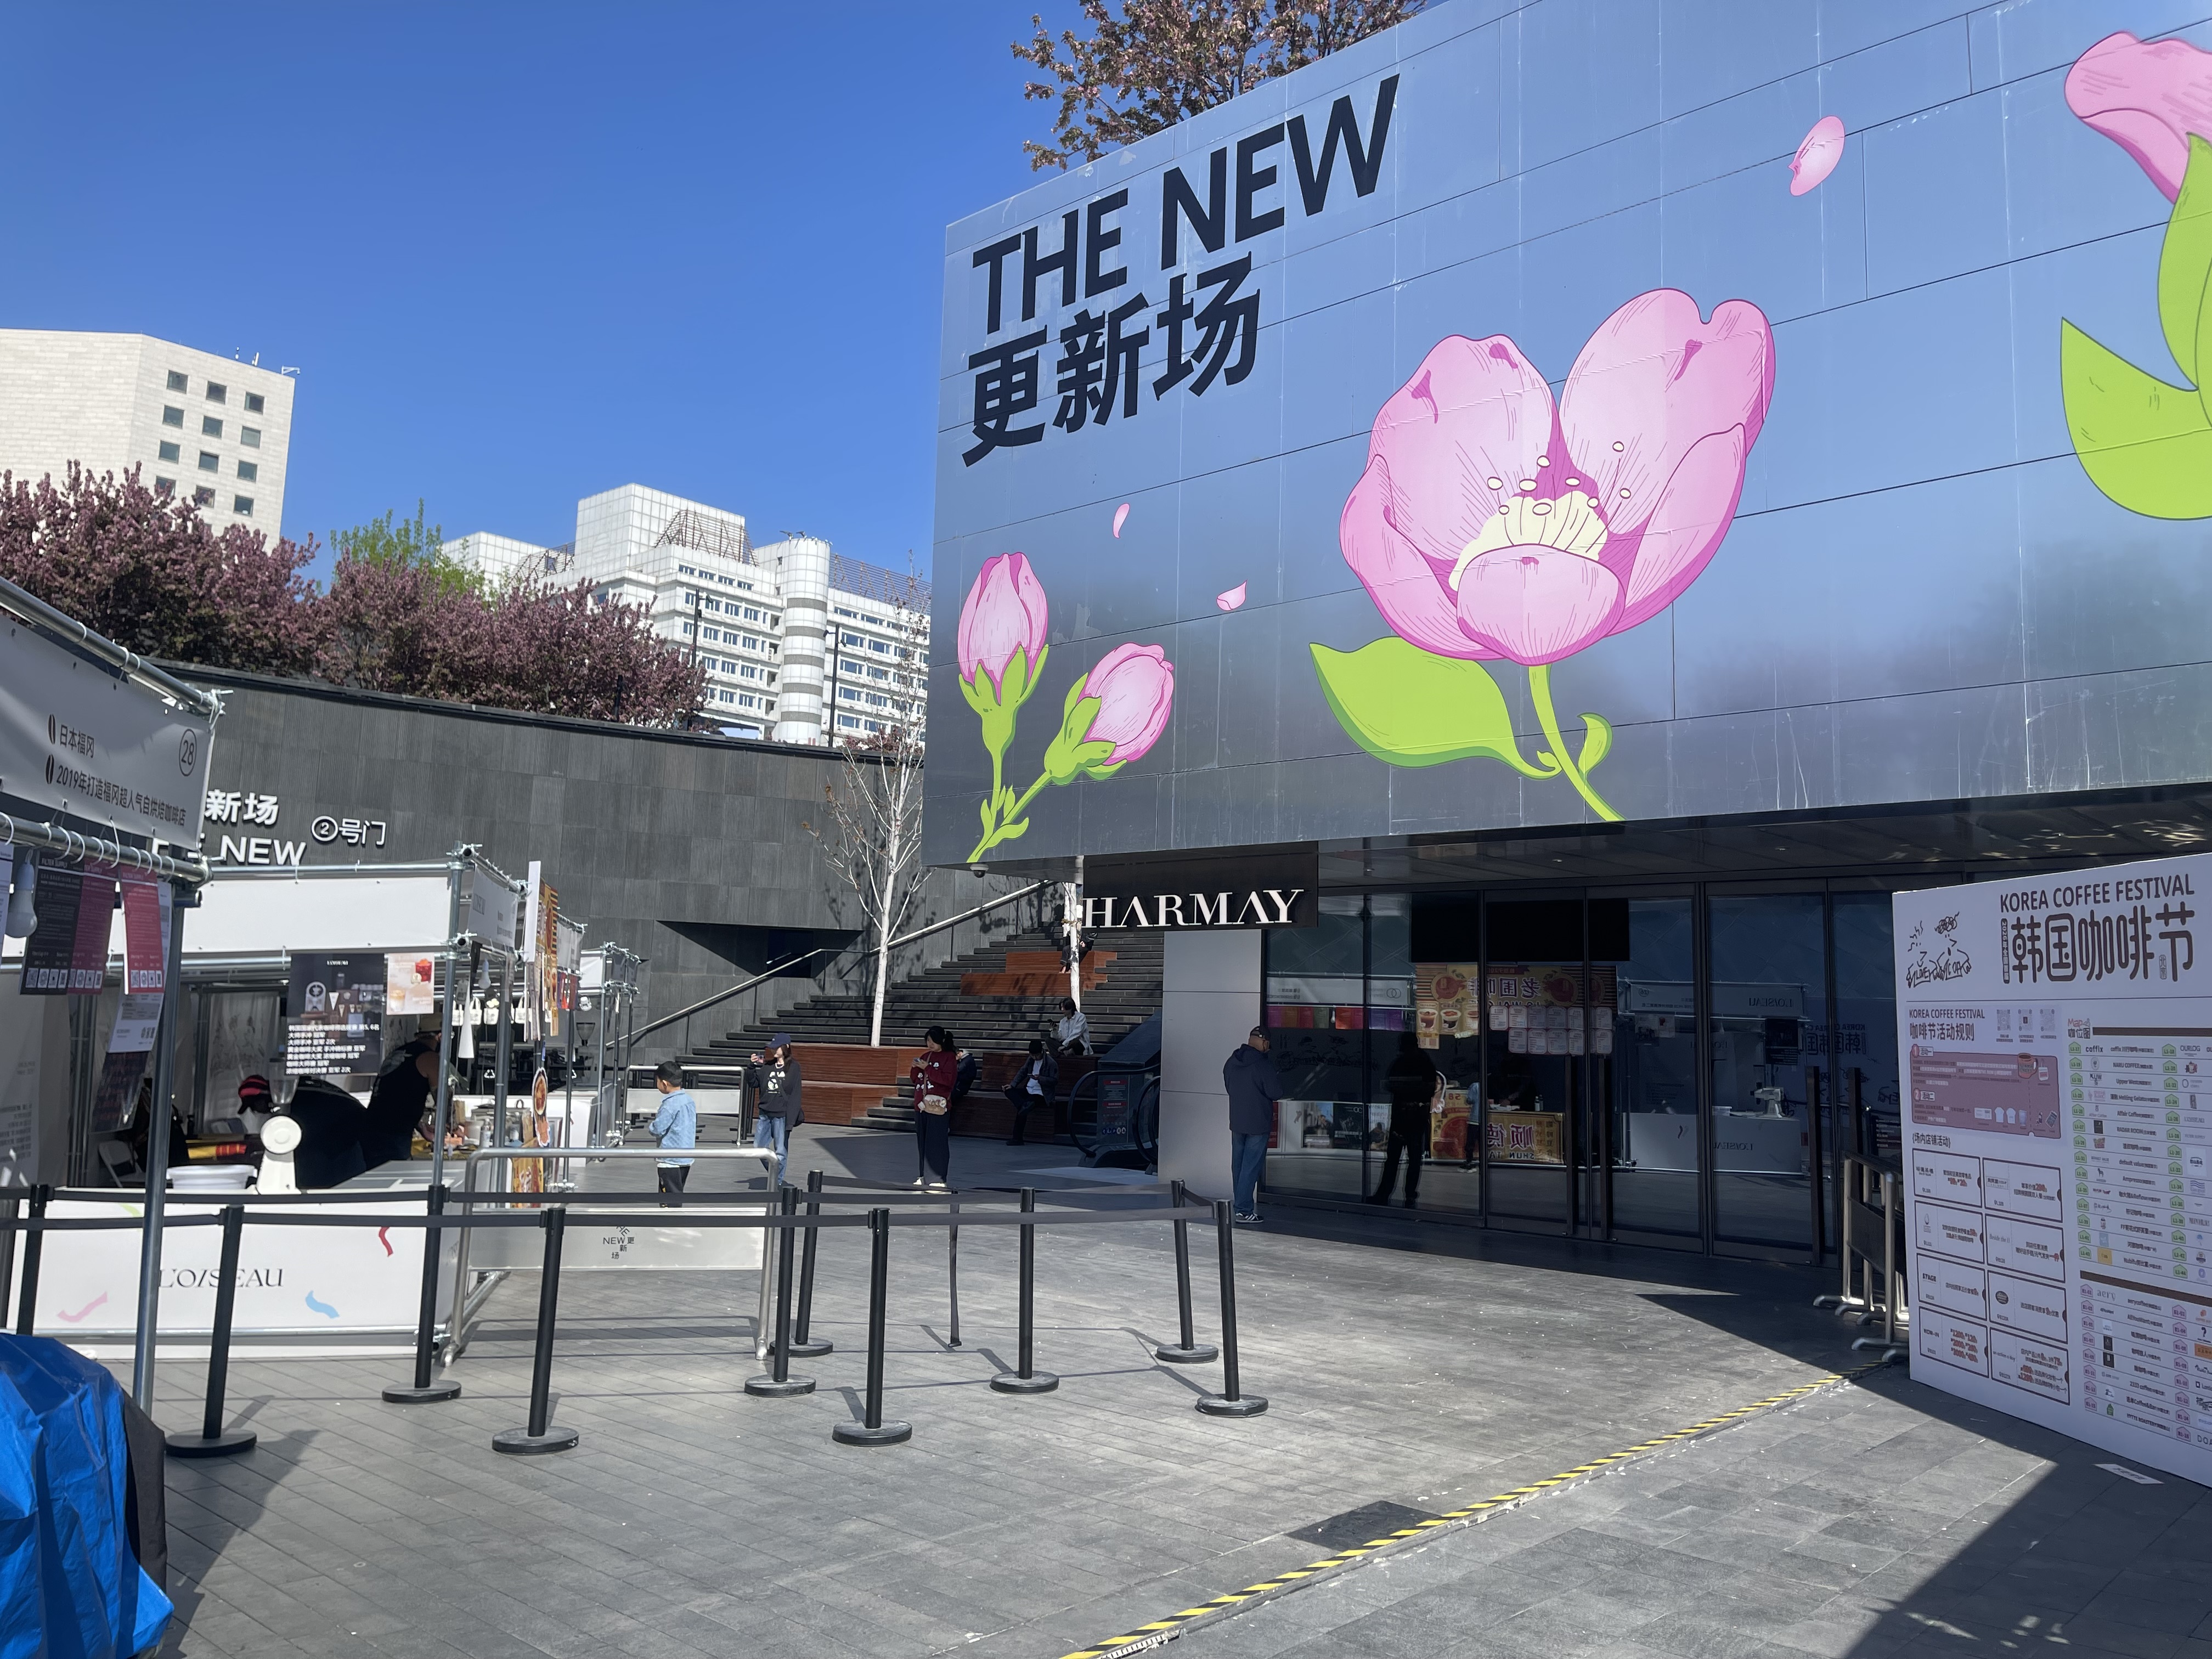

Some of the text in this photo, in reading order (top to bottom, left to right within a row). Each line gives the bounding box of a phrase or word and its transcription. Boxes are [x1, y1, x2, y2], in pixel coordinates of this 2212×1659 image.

[973, 74, 1400, 334] THE NEW
[962, 251, 1260, 467] 更新场
[60, 724, 94, 758] 日本福冈
[181, 740, 195, 766] 28
[220, 834, 307, 866] NEW
[1082, 888, 1305, 929] HARMAY
[2000, 873, 2195, 913] KOREA COFFEE FESTIVAL
[2011, 901, 2195, 984] 韩国咖啡节
[1909, 1009, 1985, 1019] KOREA COFFEE FESTIVAL
[2068, 1018, 2083, 1028] Map
[1910, 1023, 1974, 1041] 咖啡节活动规则
[603, 1237, 625, 1245] NEW
